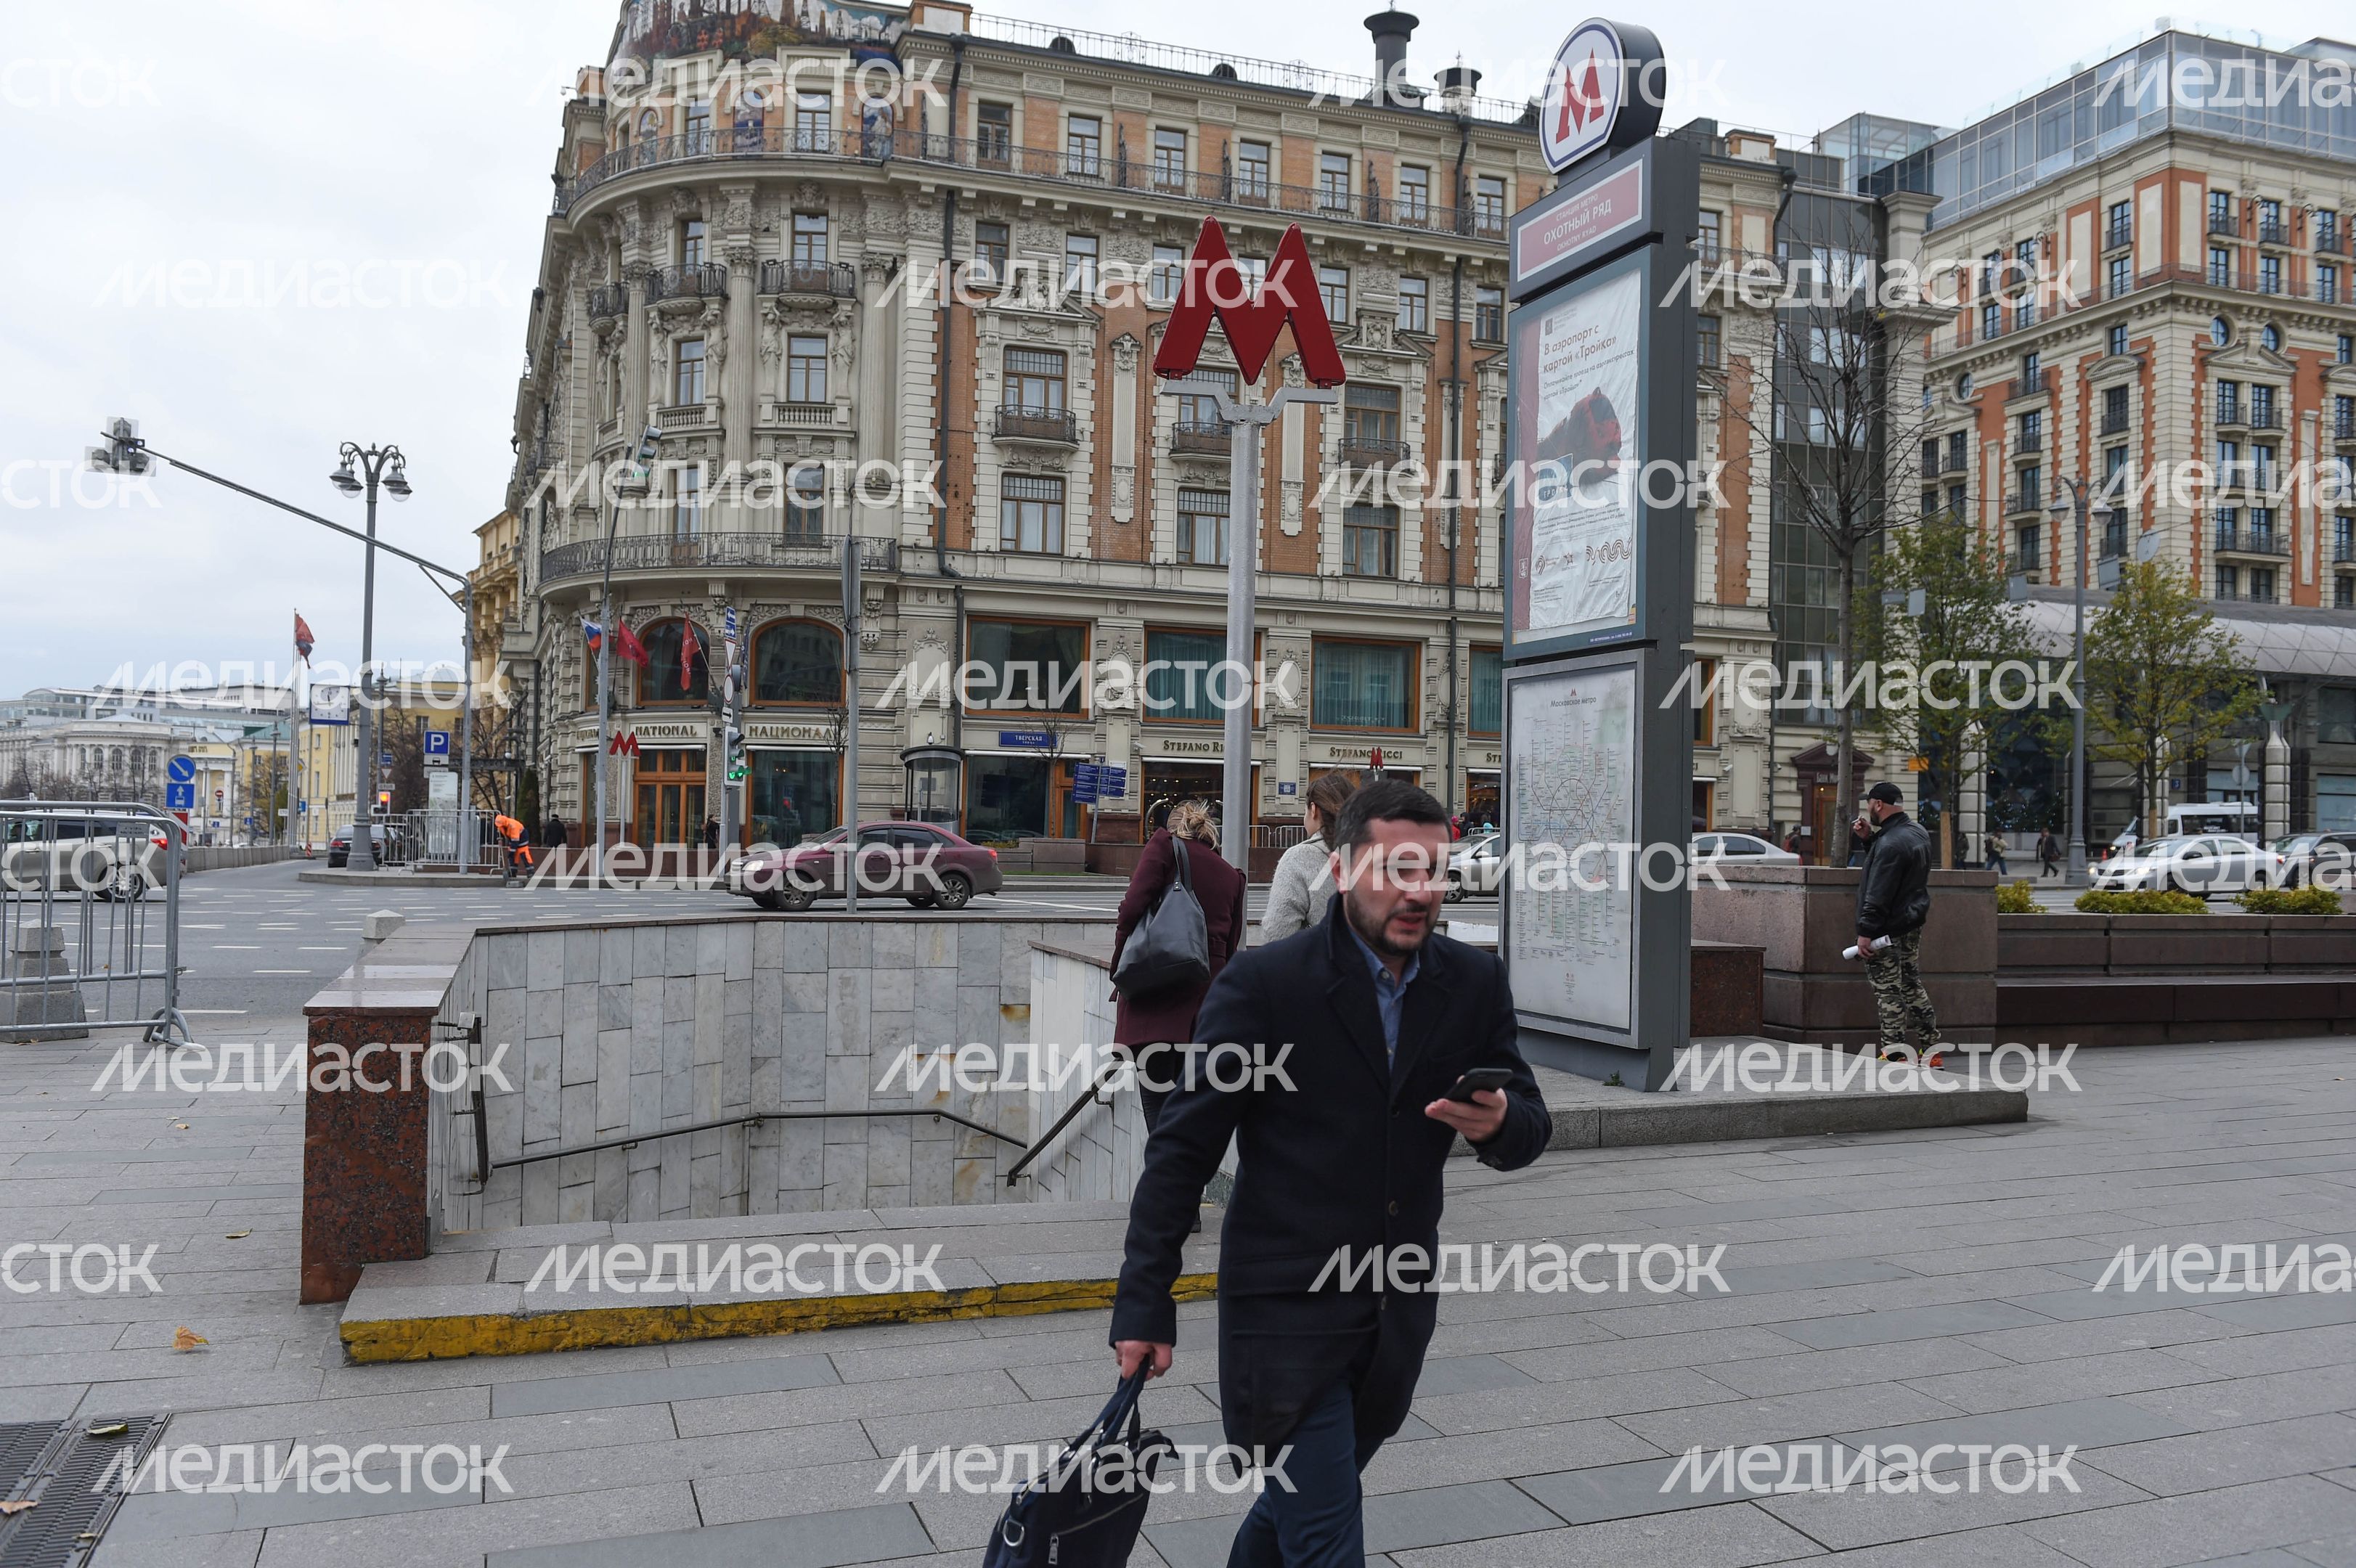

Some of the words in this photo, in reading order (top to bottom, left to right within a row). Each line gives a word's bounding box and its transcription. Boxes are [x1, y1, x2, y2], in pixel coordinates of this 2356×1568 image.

[1557, 203, 1580, 221] СТАНЦИЯ
[1581, 194, 1598, 209] МЕТРО
[1544, 208, 1590, 245] ОХОТНЫЙ
[1592, 198, 1612, 220] РЯД
[1557, 234, 1581, 251] OKHOTNY
[1582, 225, 1597, 239] RYAD
[1544, 343, 1549, 356] В
[1552, 327, 1592, 352] аэропорт
[1594, 324, 1599, 334] с
[1544, 351, 1573, 373] картой
[1575, 336, 1617, 361] «Тройка»
[1550, 699, 1581, 708] Московское
[635, 725, 697, 736] NATIONAL
